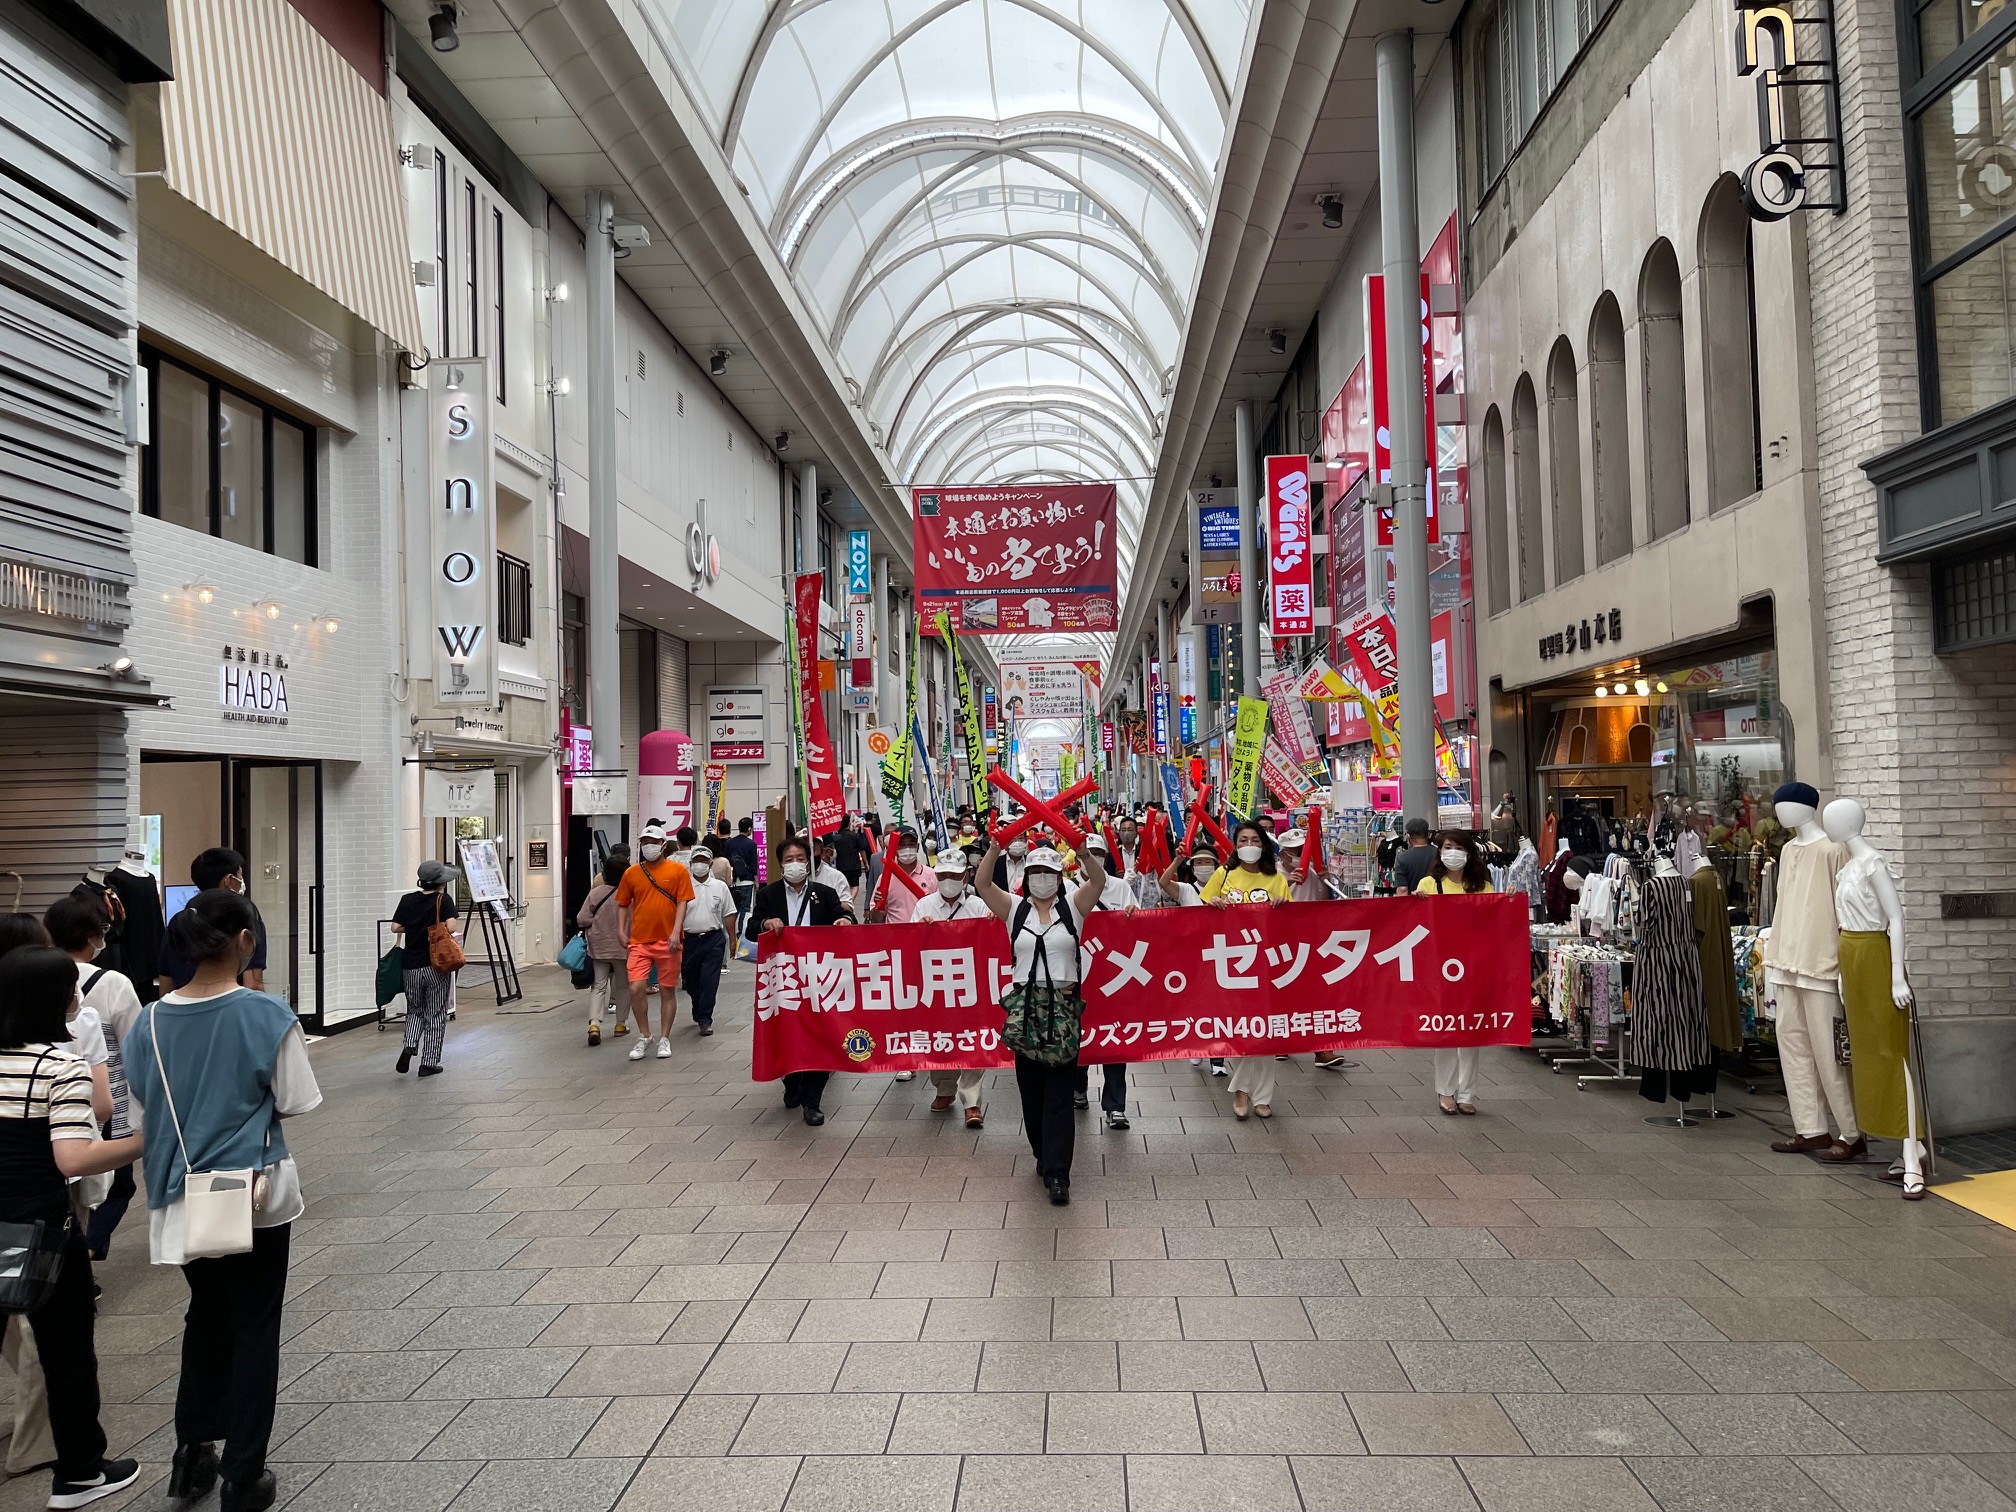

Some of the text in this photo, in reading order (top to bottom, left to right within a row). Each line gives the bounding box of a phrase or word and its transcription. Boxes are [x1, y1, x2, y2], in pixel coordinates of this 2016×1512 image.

[1198, 493, 1215, 503] 2F
[1203, 511, 1226, 523] VINTAGE
[1273, 470, 1308, 573] Wants
[437, 403, 483, 660] snow
[852, 536, 867, 588] NOVA
[1281, 589, 1305, 613] 薬
[1201, 608, 1218, 619] 1F
[857, 609, 866, 652] docomo
[1566, 608, 1622, 654] 多山本店
[223, 666, 289, 712] HABA
[716, 698, 734, 712] glo
[854, 696, 870, 705] UQ
[224, 712, 289, 726] HEALTH AID BEAUTY AID
[485, 721, 504, 731] terrace
[716, 723, 735, 738] glo
[1104, 726, 1113, 749] JINS
[732, 748, 763, 756] コスモス
[1418, 1012, 1514, 1033] 2021.7.17
[849, 1029, 869, 1037] LIONS
[855, 1038, 865, 1051] L
